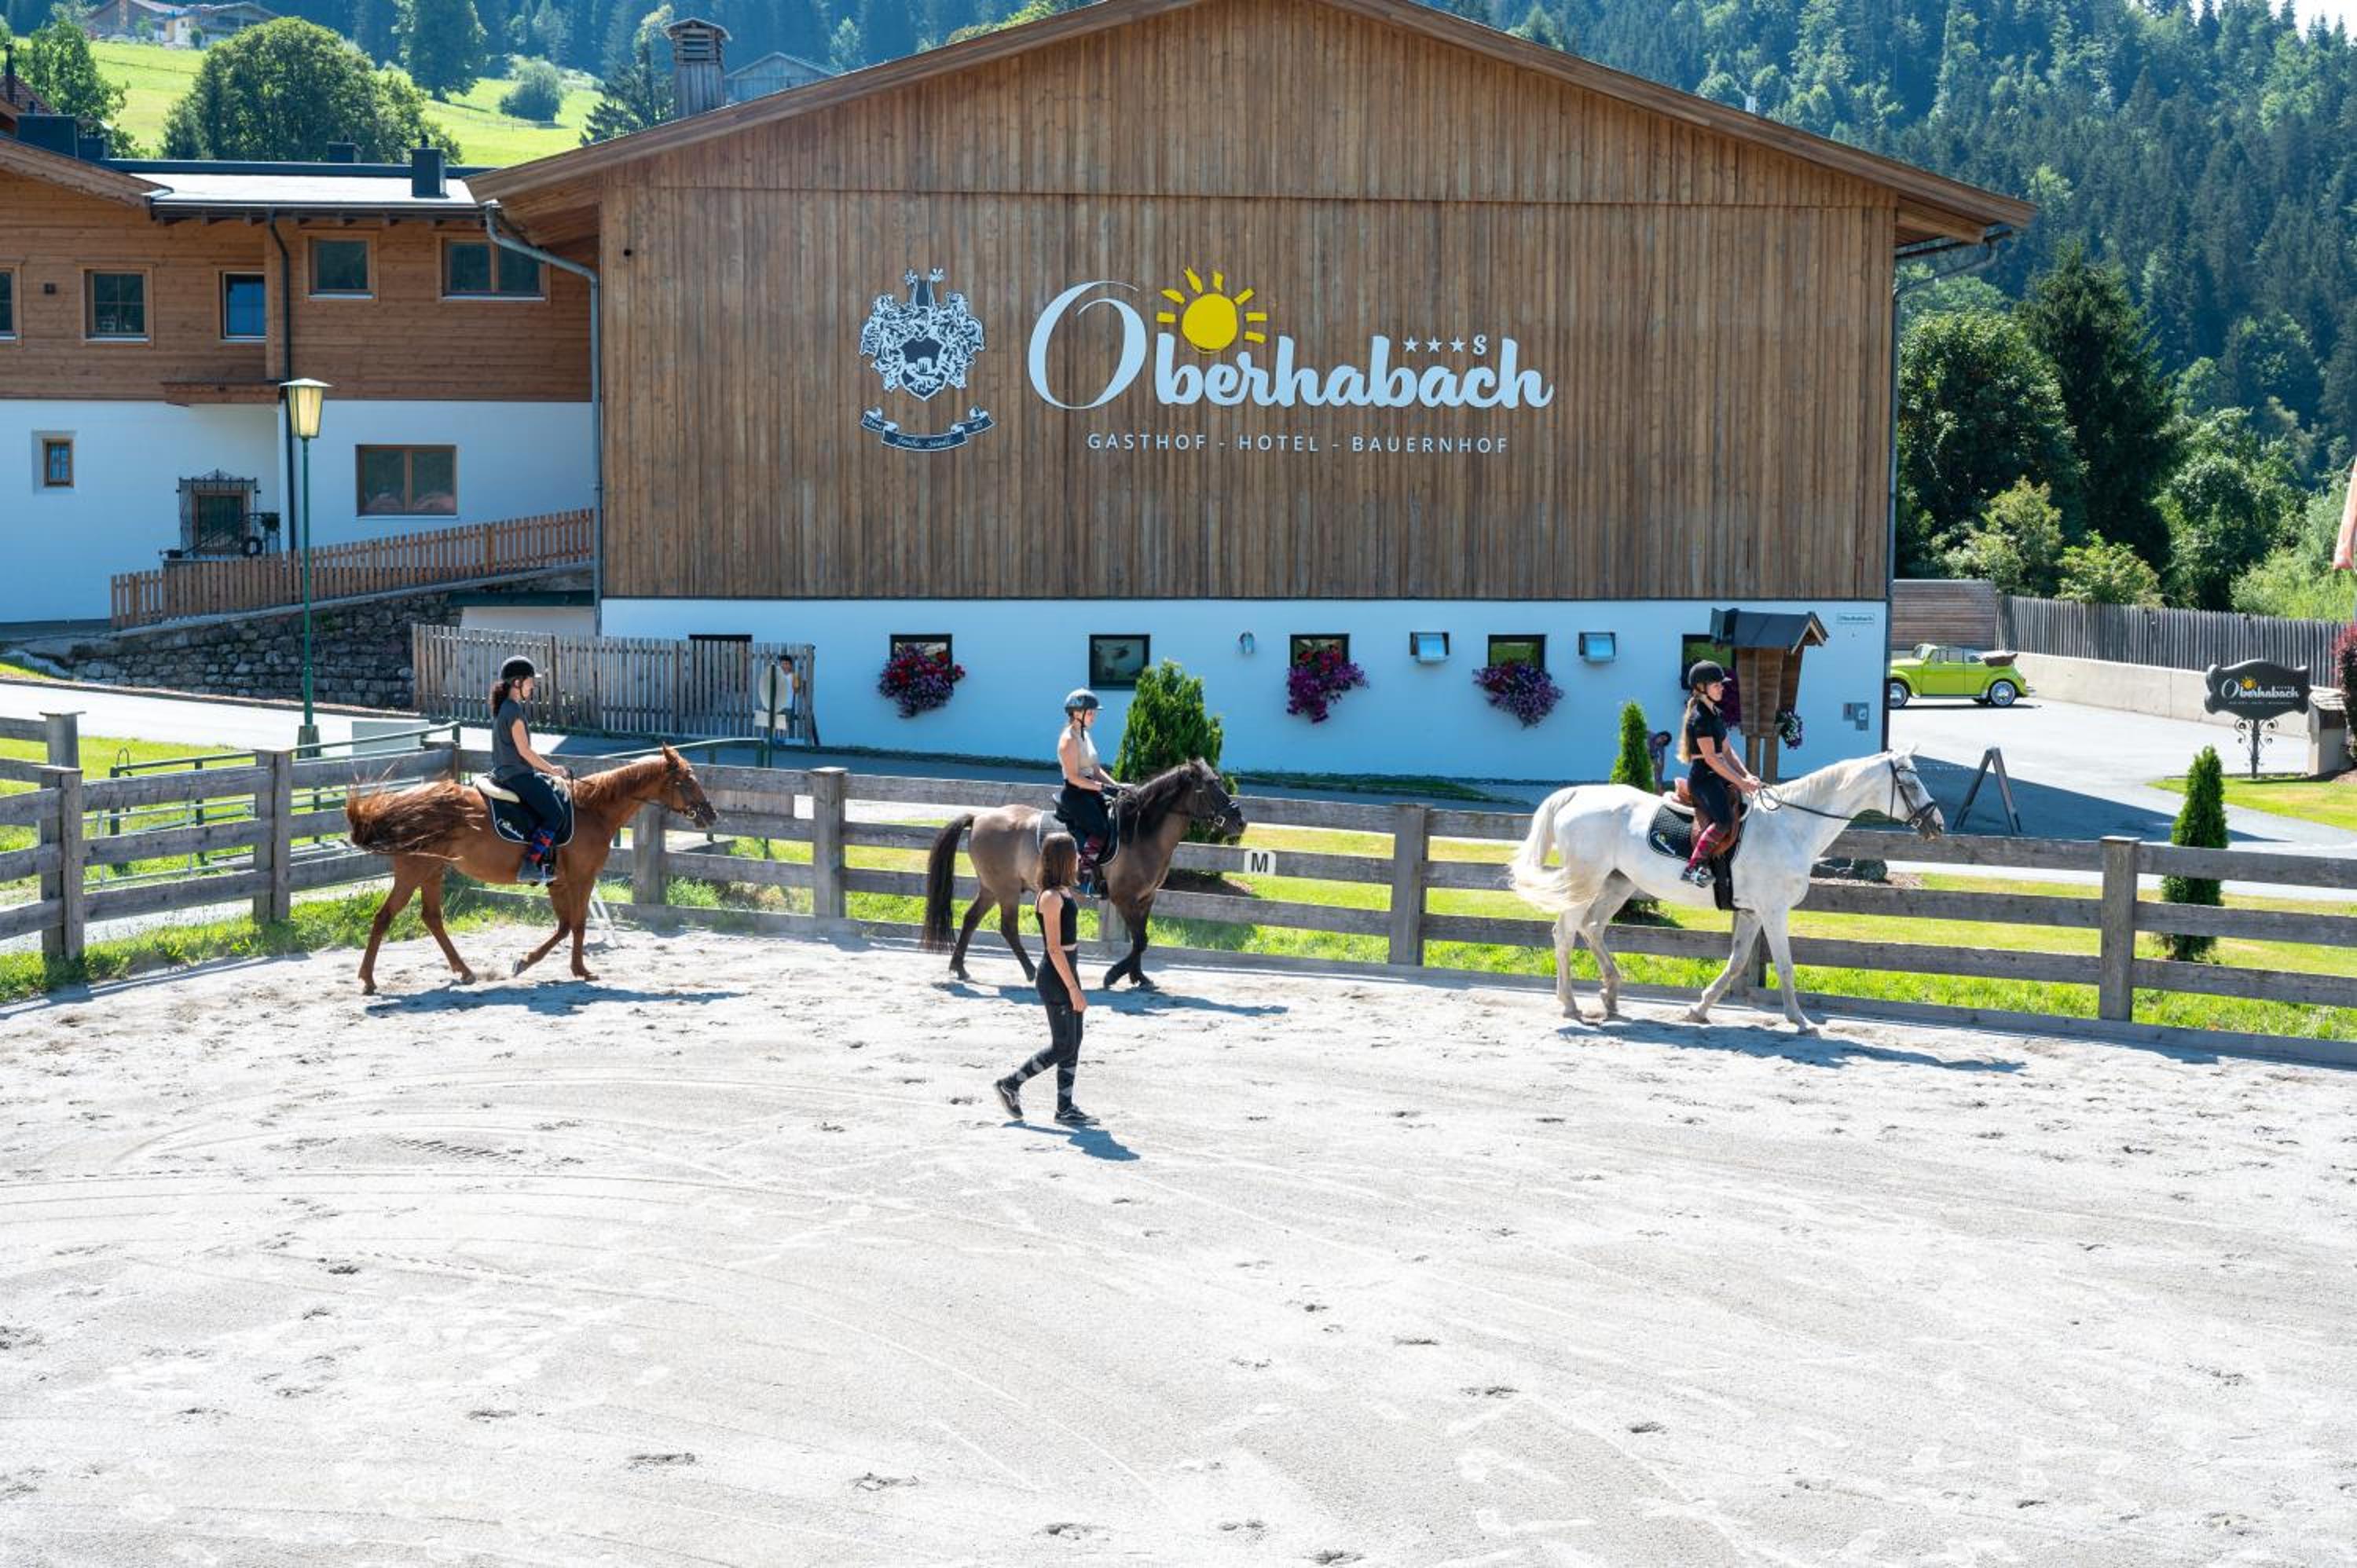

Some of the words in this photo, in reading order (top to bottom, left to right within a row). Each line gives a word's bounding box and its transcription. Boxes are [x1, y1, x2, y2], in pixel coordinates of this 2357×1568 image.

[1028, 280, 1555, 410] Oberhabach
[1087, 434, 1207, 450] GASTHOF
[1238, 434, 1319, 452] HOTEL
[1351, 436, 1508, 454] BAUERNHOF
[1251, 852, 1269, 873] M
